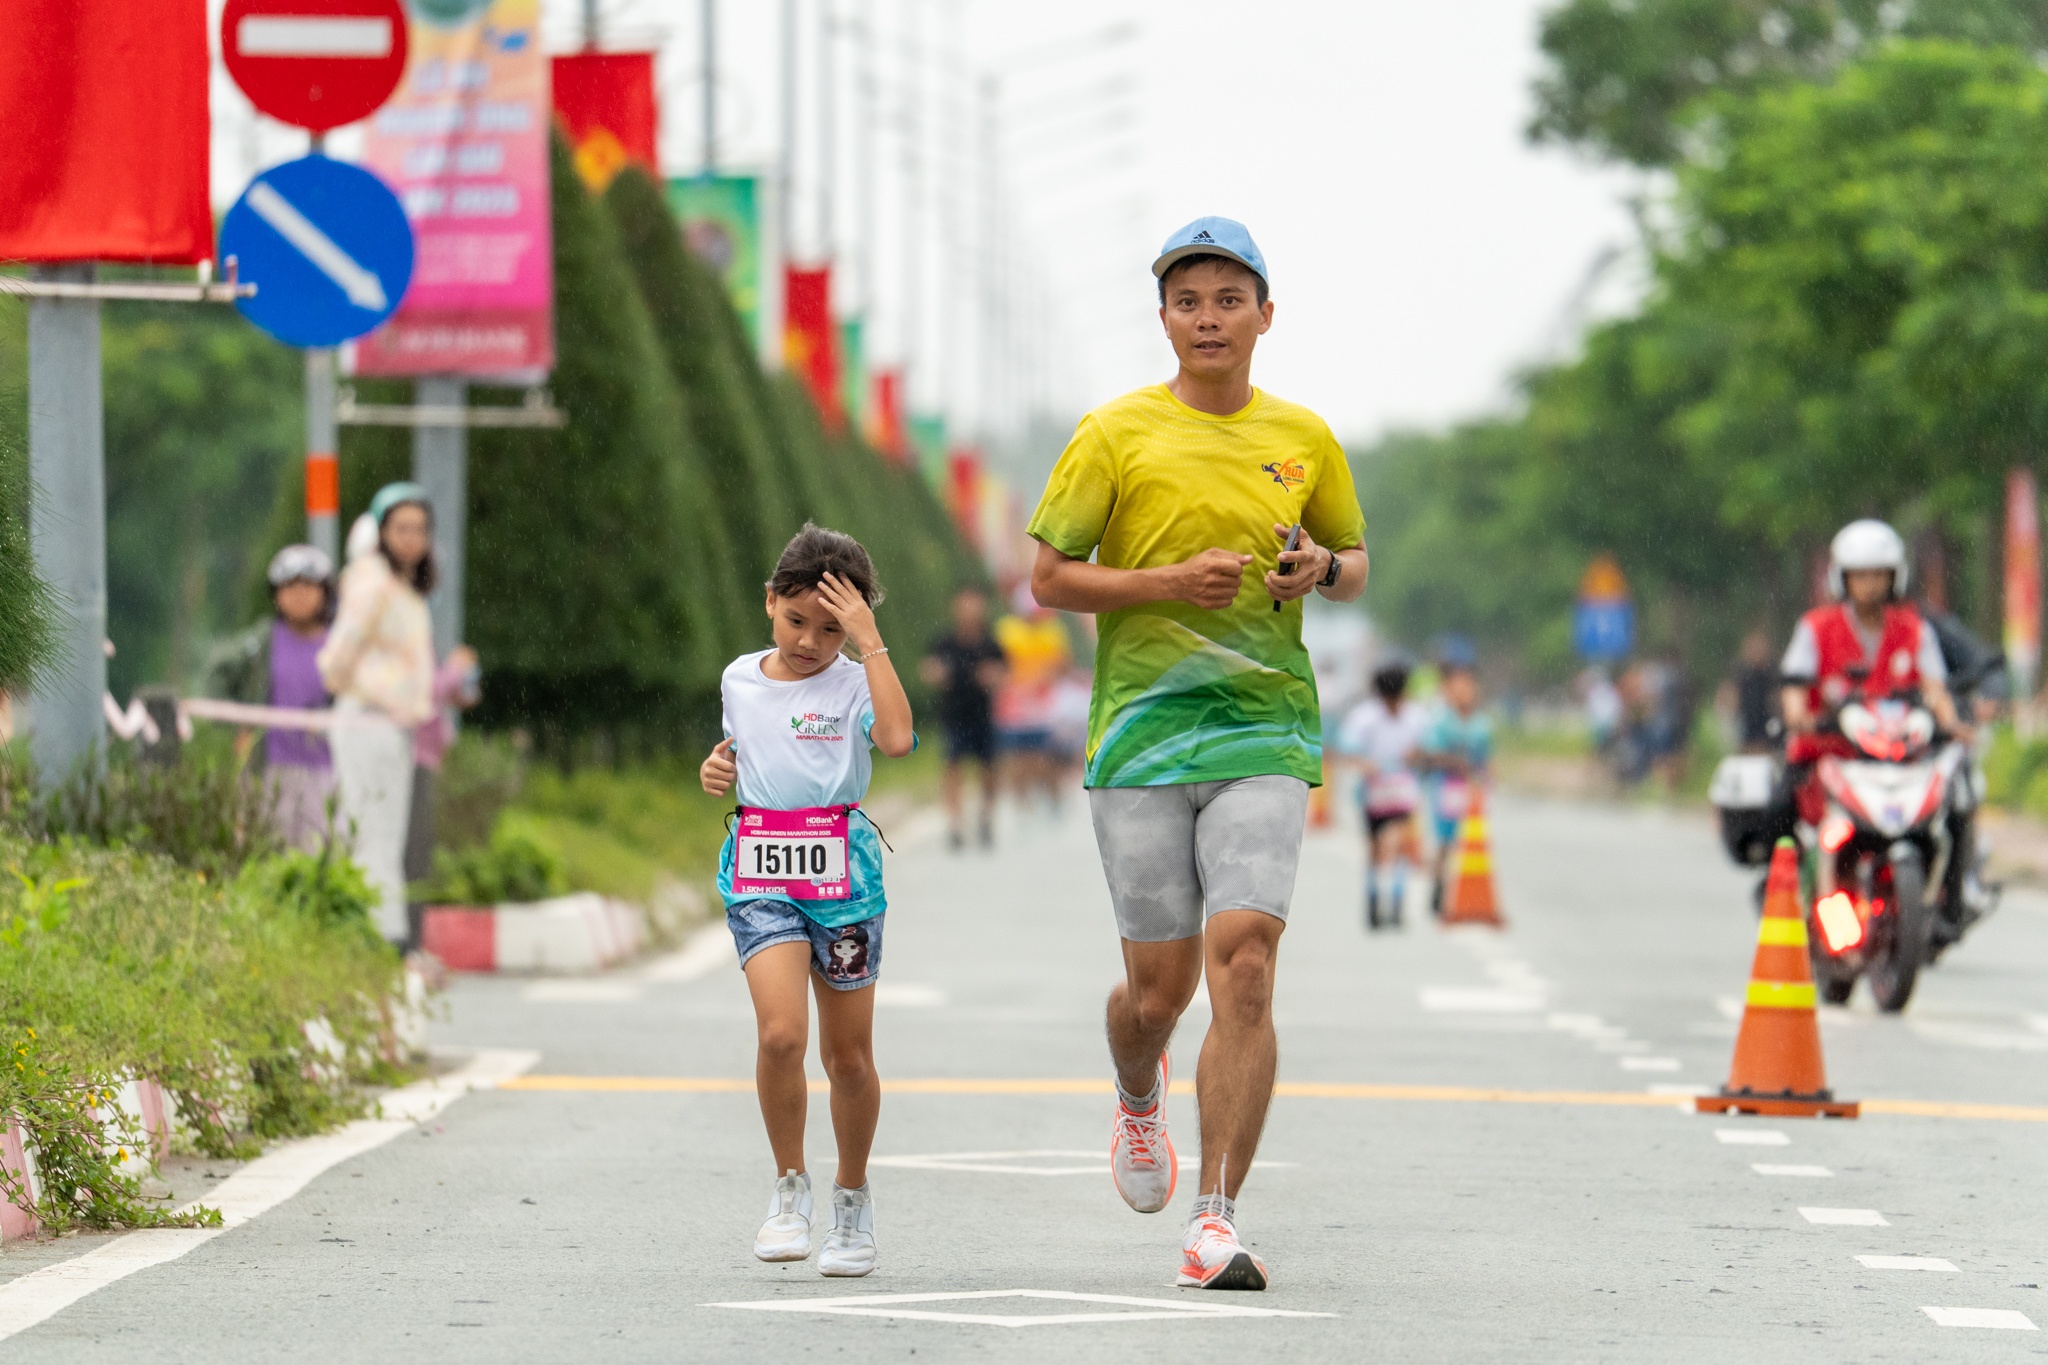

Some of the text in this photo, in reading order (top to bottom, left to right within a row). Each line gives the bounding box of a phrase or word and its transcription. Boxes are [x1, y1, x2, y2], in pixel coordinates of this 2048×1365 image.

[1284, 466, 1304, 479] RUN
[804, 713, 839, 722] HDBank
[797, 721, 838, 735] GREEN
[806, 816, 833, 824] HDBank
[754, 844, 826, 874] 15110
[765, 886, 787, 894] KIDS
